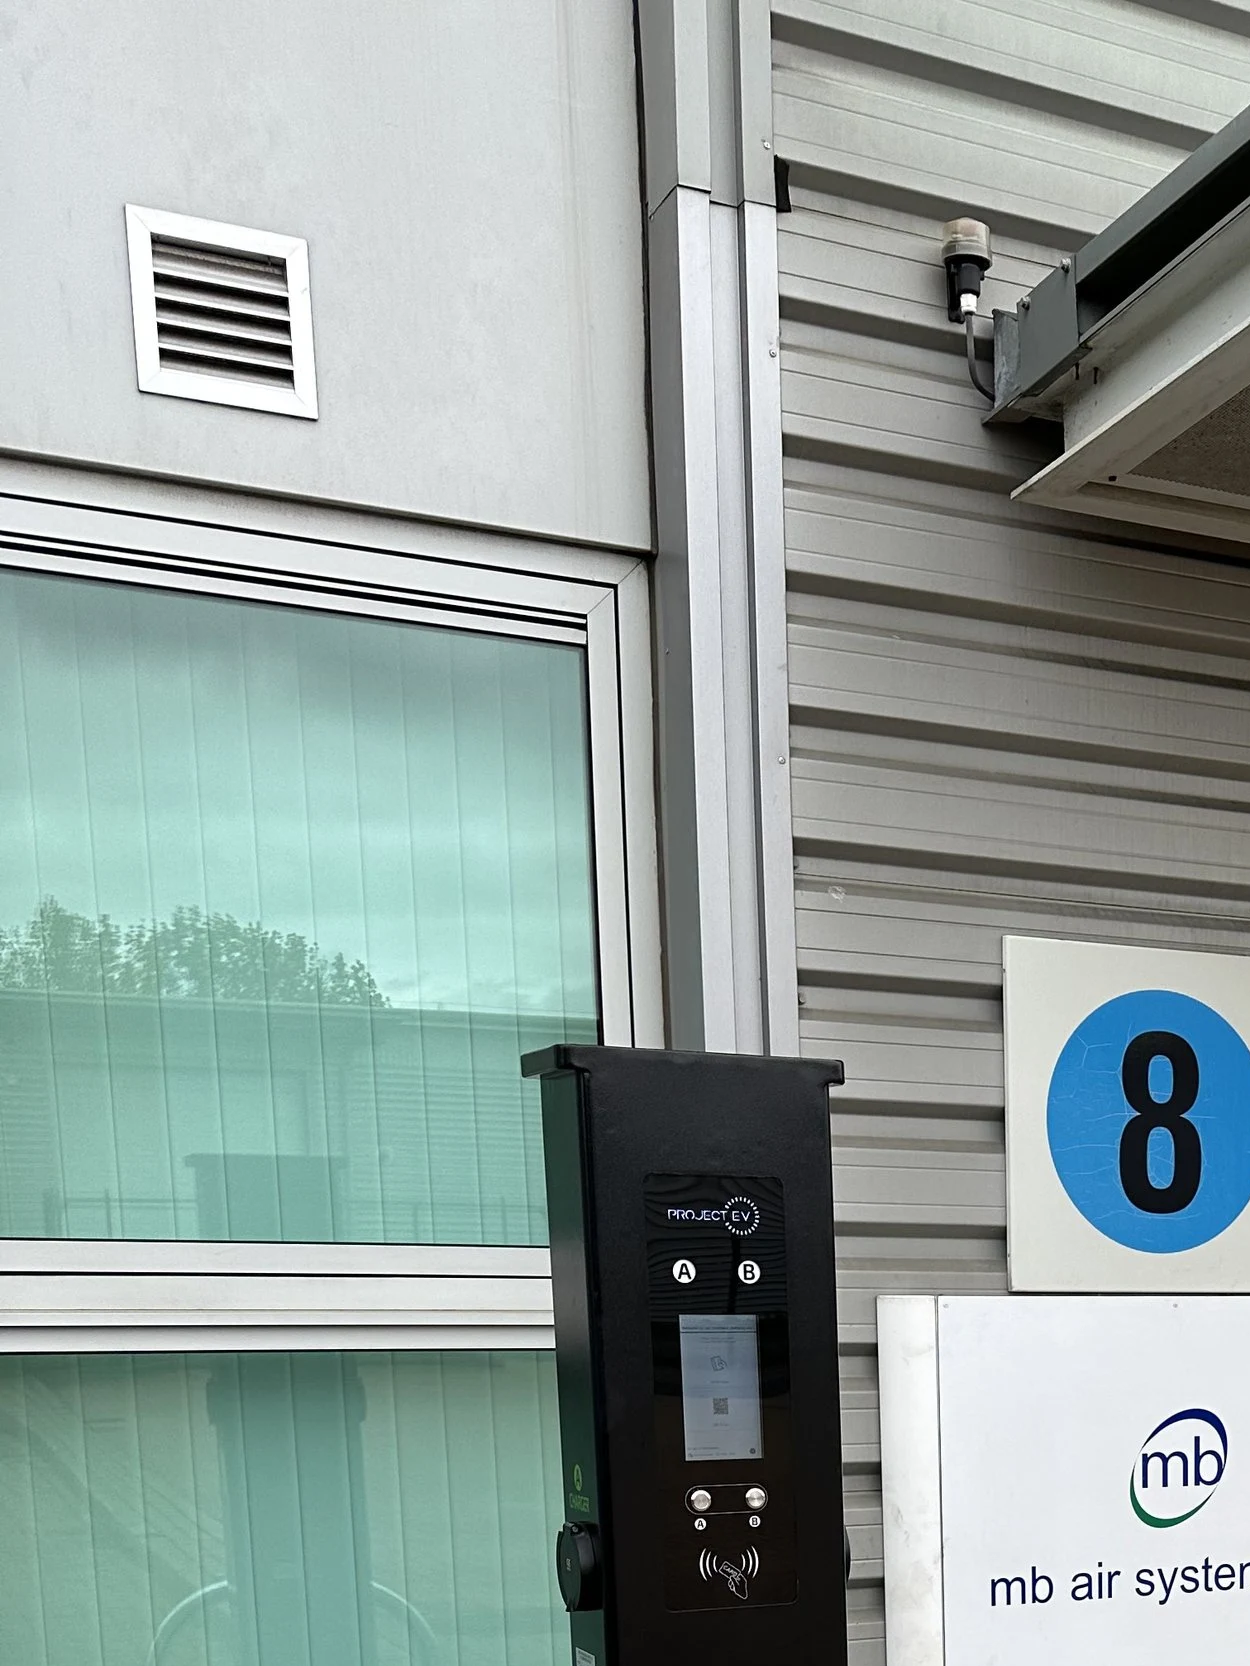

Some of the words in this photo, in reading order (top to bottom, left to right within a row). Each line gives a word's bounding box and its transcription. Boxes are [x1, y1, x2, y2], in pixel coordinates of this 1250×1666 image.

[1119, 1030, 1202, 1214] 8
[667, 1208, 727, 1221] PROJECT
[731, 1210, 751, 1221] EV
[677, 1262, 692, 1280] A
[1141, 1435, 1224, 1488] mb
[990, 1566, 1054, 1606] mb
[1071, 1561, 1121, 1601] air
